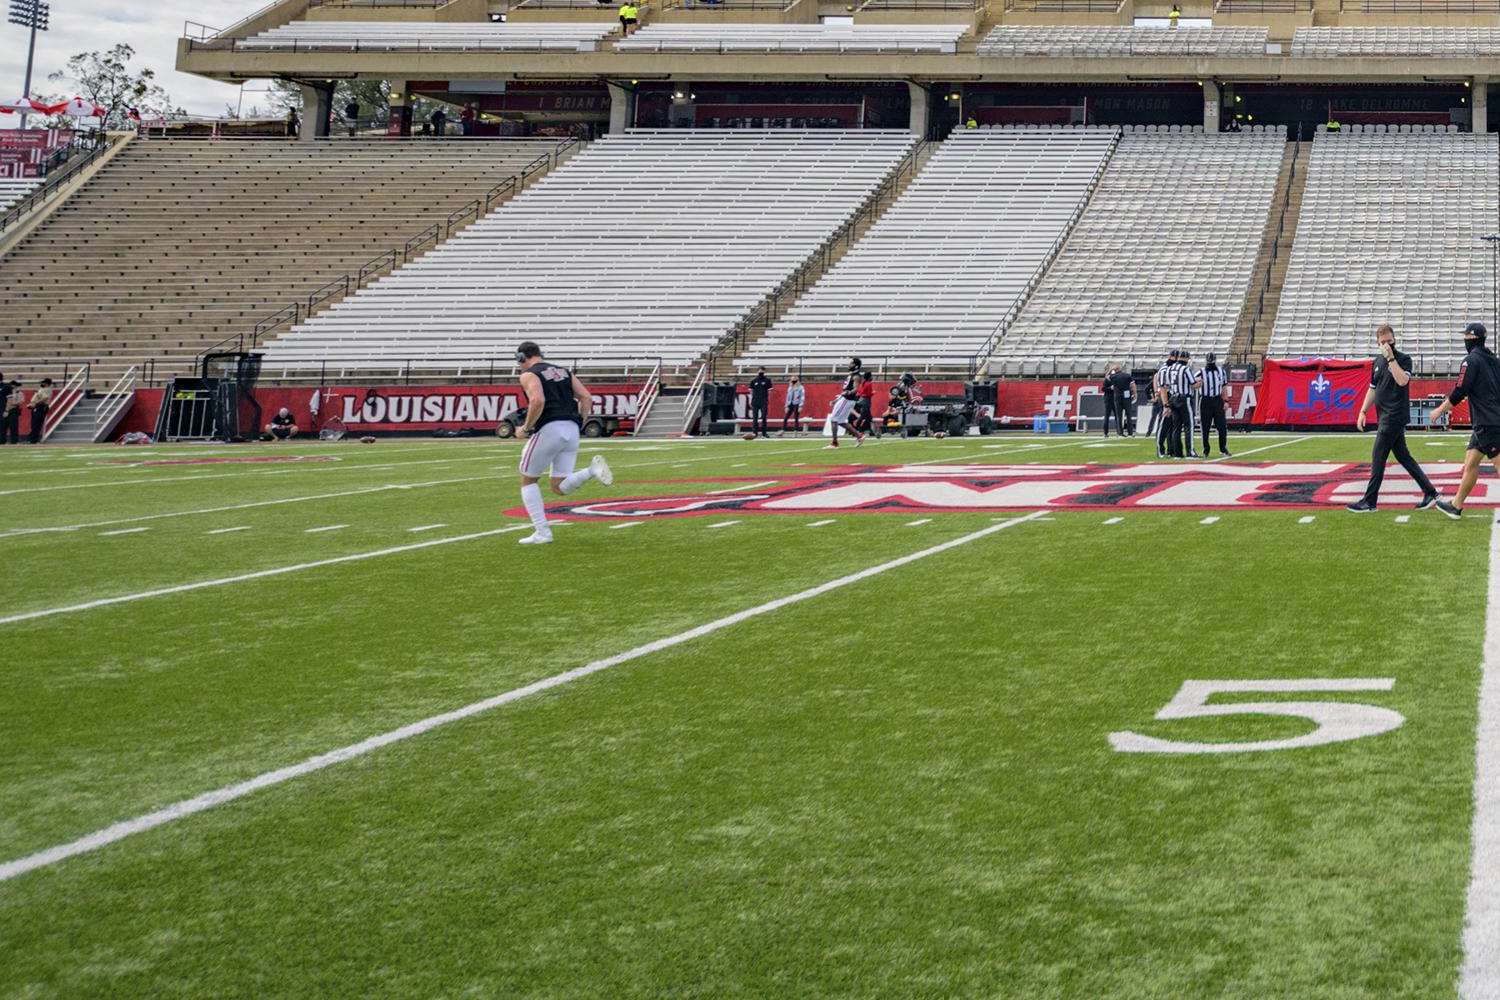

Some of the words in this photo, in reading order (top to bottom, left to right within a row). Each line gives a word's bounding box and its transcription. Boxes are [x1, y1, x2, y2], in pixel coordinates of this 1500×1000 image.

[554, 97, 595, 109] BRIAN
[343, 394, 520, 424] LOUISIANA
[1286, 382, 1356, 409] LHC
